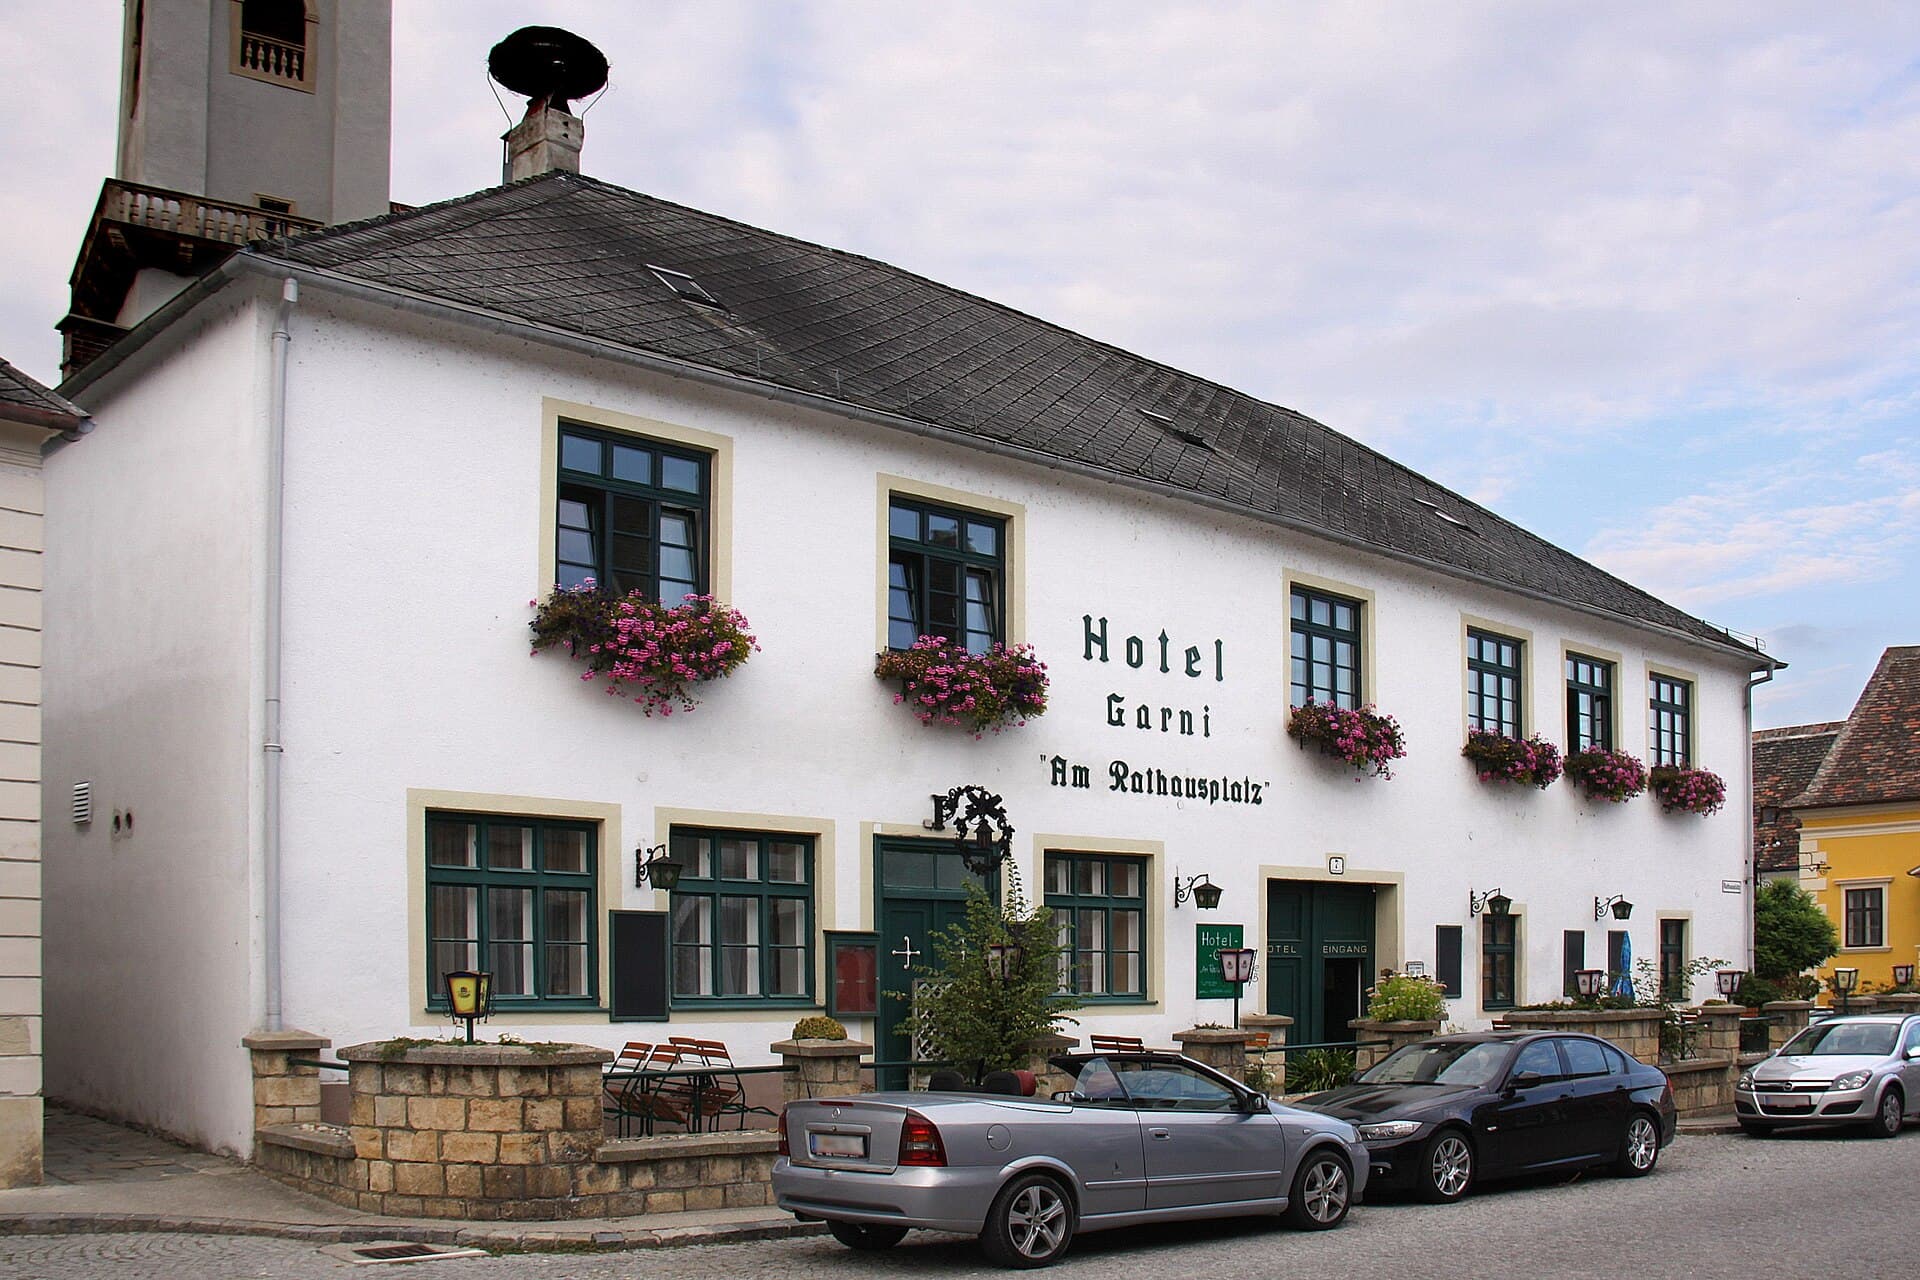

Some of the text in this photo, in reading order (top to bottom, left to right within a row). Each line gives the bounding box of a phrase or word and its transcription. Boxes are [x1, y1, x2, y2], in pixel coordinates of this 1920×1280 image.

[1082, 613, 1224, 682] Hotel
[1106, 692, 1211, 738] Garni
[1267, 945, 1368, 954] OTEL EINGANG
